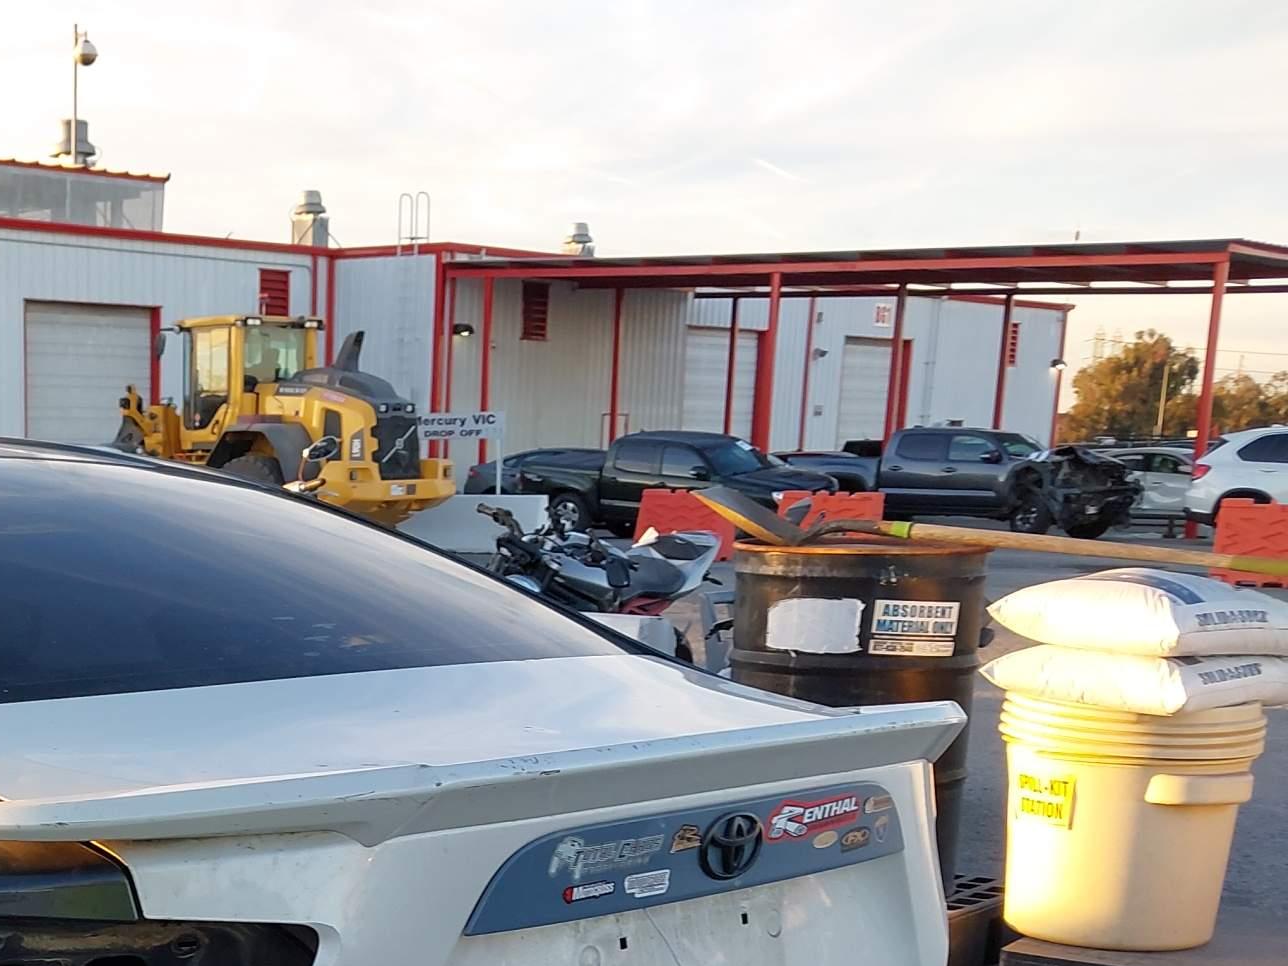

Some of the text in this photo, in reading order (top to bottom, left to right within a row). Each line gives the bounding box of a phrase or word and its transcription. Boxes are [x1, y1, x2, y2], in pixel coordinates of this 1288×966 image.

[472, 414, 496, 425] VIC
[459, 429, 482, 437] OFF
[882, 604, 953, 618] ABSORBENT
[876, 619, 929, 633] MATERIAL
